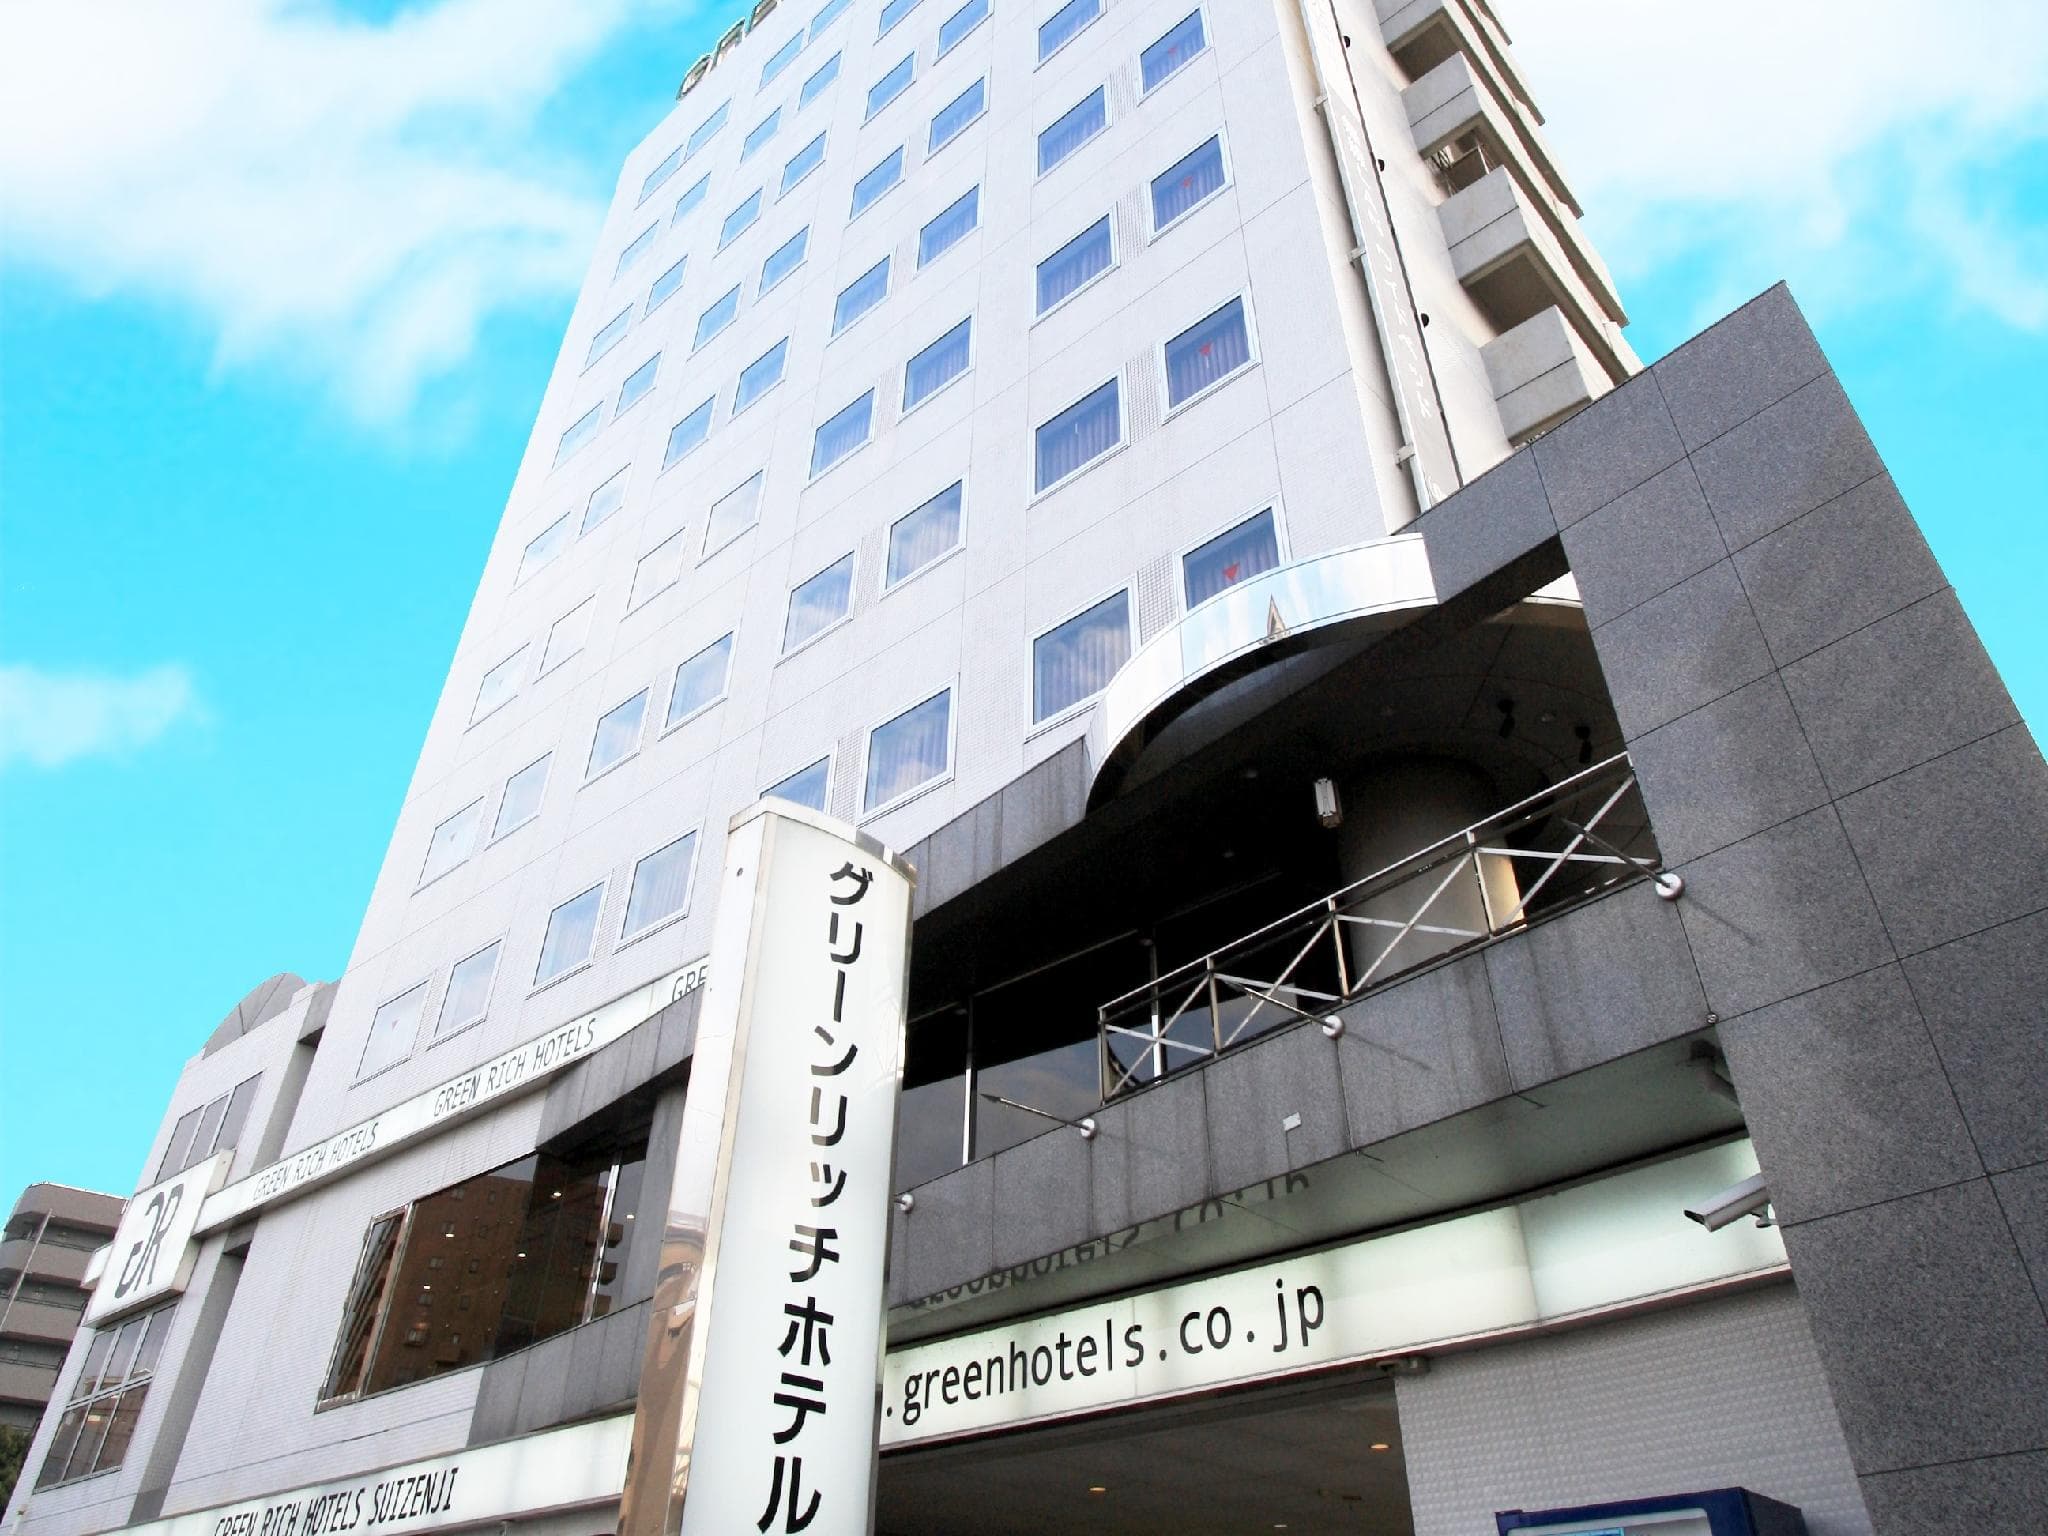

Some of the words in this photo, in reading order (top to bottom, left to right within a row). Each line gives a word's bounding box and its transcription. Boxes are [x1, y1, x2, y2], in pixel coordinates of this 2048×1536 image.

[434, 1073, 482, 1117] GREEN
[485, 1050, 527, 1093] RICH
[532, 1017, 596, 1071] HOTELS
[252, 1163, 293, 1201] GREEN
[293, 1142, 328, 1181] RICH
[327, 1121, 379, 1162] HOTELS
[757, 861, 874, 1535] グリーンリッチホテル
[260, 1501, 301, 1536] RICH
[301, 1487, 366, 1536] HOTELS
[367, 1467, 459, 1526] SUIZENJI
